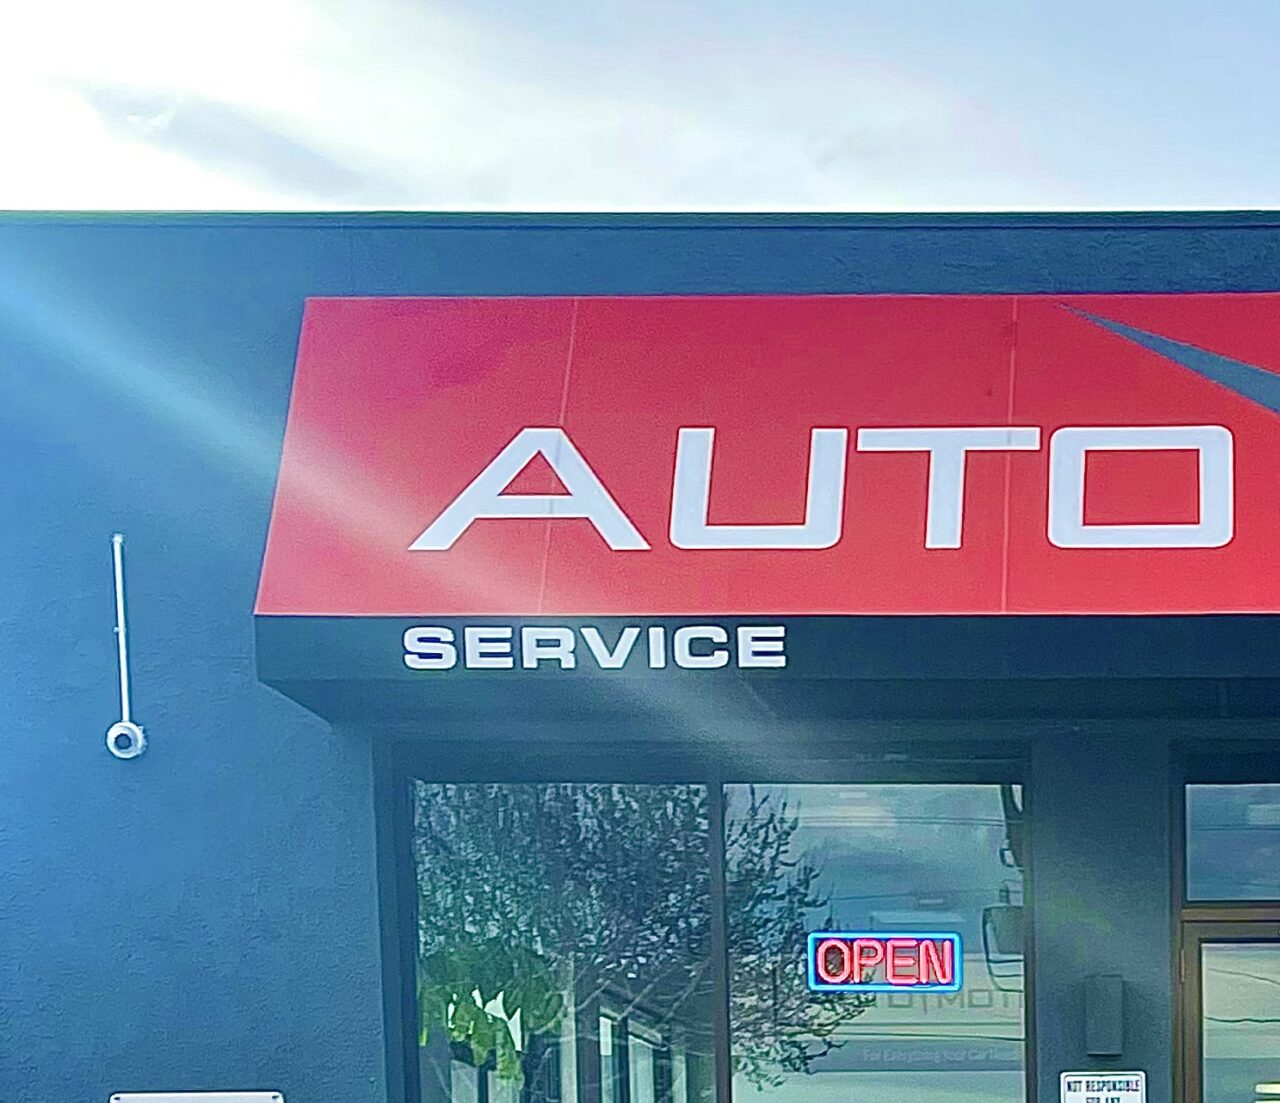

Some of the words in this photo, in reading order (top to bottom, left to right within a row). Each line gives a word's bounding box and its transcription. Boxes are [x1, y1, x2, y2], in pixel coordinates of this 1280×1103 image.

[408, 425, 1234, 551] AUTO
[402, 624, 788, 670] SERVICE
[815, 938, 954, 986] OPEN
[1067, 1080, 1082, 1092] NOT
[1086, 1080, 1140, 1092] RESPONSIBLE
